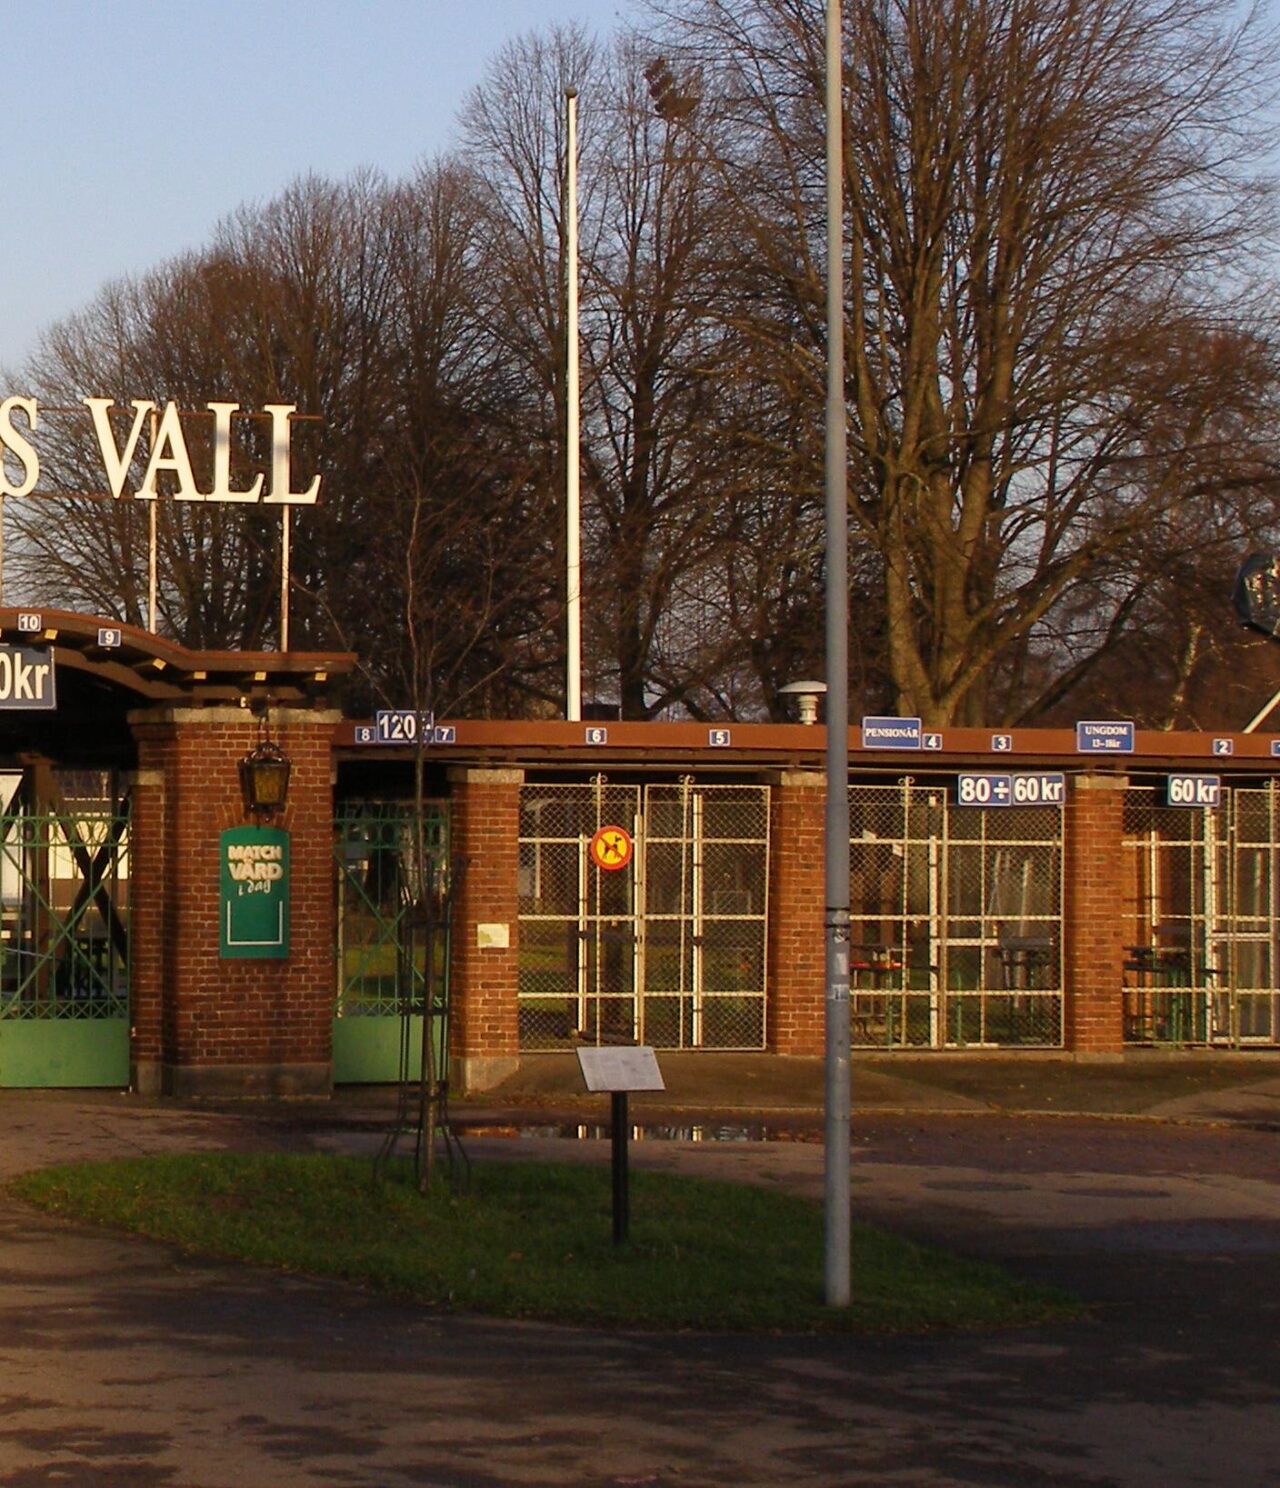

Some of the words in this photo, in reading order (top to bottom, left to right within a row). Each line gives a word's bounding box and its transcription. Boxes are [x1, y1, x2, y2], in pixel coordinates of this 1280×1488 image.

[82, 397, 322, 505] VALL
[21, 616, 39, 629] 10
[104, 631, 115, 644] 9
[361, 728, 370, 741] 8
[441, 728, 450, 741] 7
[592, 730, 601, 742] 6
[865, 727, 918, 738] PENSIONÄR
[1085, 726, 1128, 735] UNGDOM
[715, 731, 725, 744] 5
[928, 736, 937, 748] 4
[998, 737, 1007, 749] 3
[1219, 741, 1228, 753] 2
[228, 845, 282, 860] MATCH
